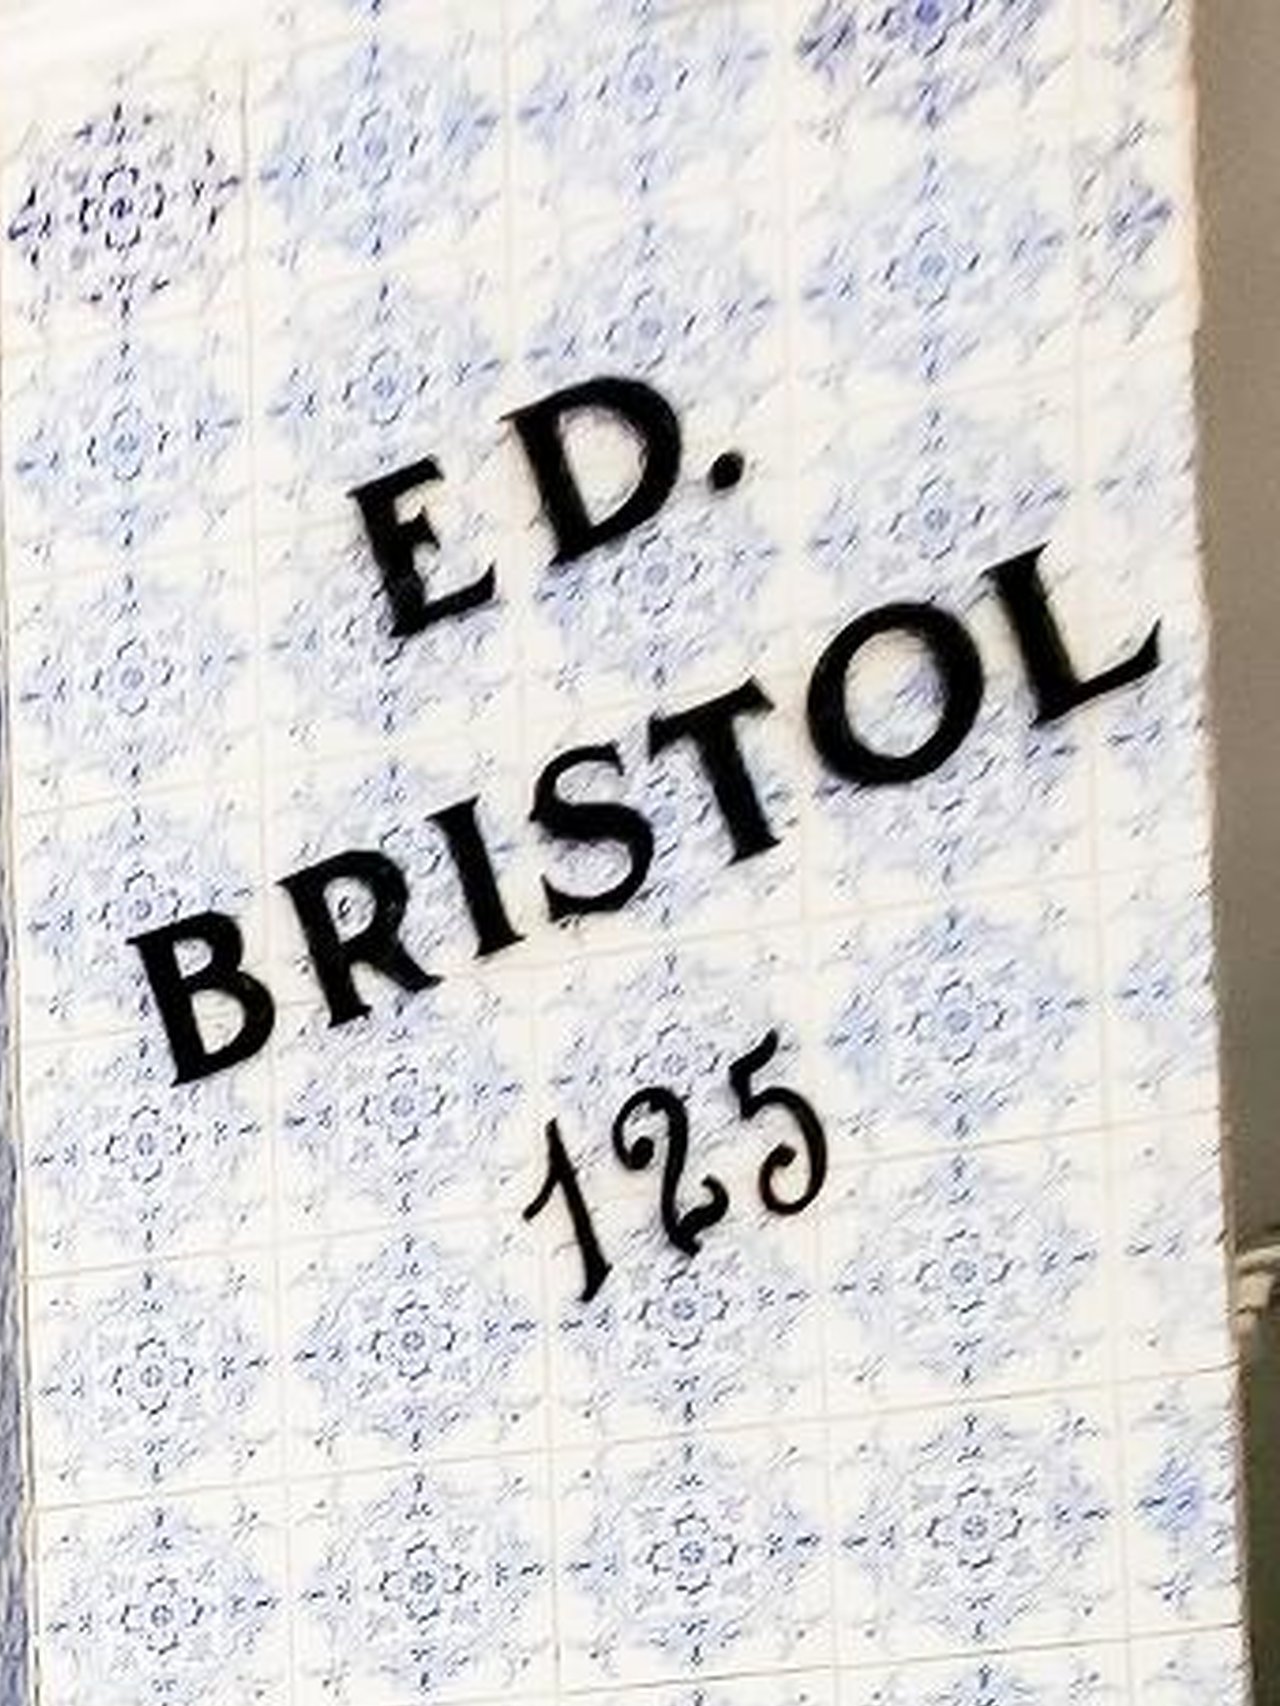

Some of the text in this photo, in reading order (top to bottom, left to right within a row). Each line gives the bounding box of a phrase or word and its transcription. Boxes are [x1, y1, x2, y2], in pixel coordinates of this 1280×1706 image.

[347, 375, 746, 641] ED.
[124, 543, 1162, 1088] BRISTOL
[521, 1029, 829, 1304] 125
